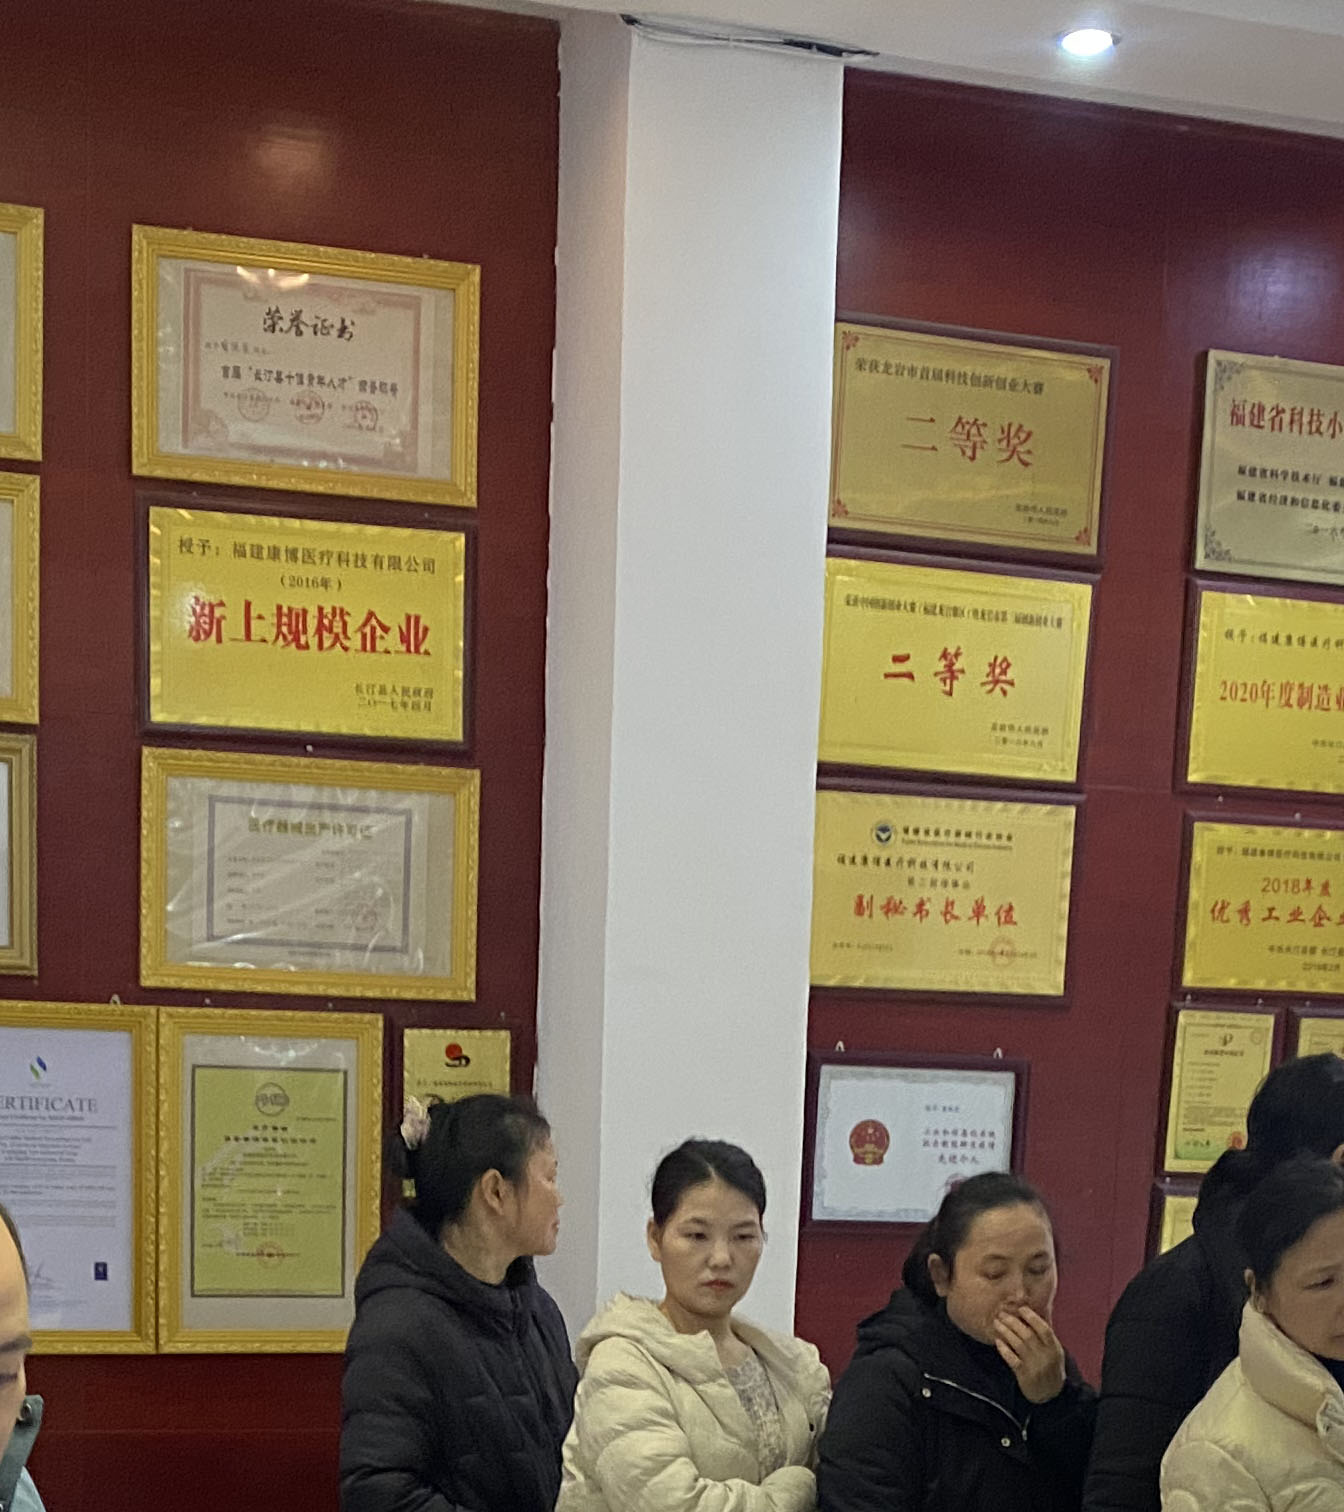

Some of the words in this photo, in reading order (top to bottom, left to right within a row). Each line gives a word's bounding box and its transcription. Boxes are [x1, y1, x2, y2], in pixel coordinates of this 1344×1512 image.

[263, 306, 356, 341] 荣誉证书
[901, 415, 1033, 468] 二等奖
[188, 595, 431, 656] 新上规模企业
[883, 645, 1015, 697] 二等奖
[1261, 877, 1331, 897] 2018年度
[854, 894, 1017, 927] 副秘书长单位
